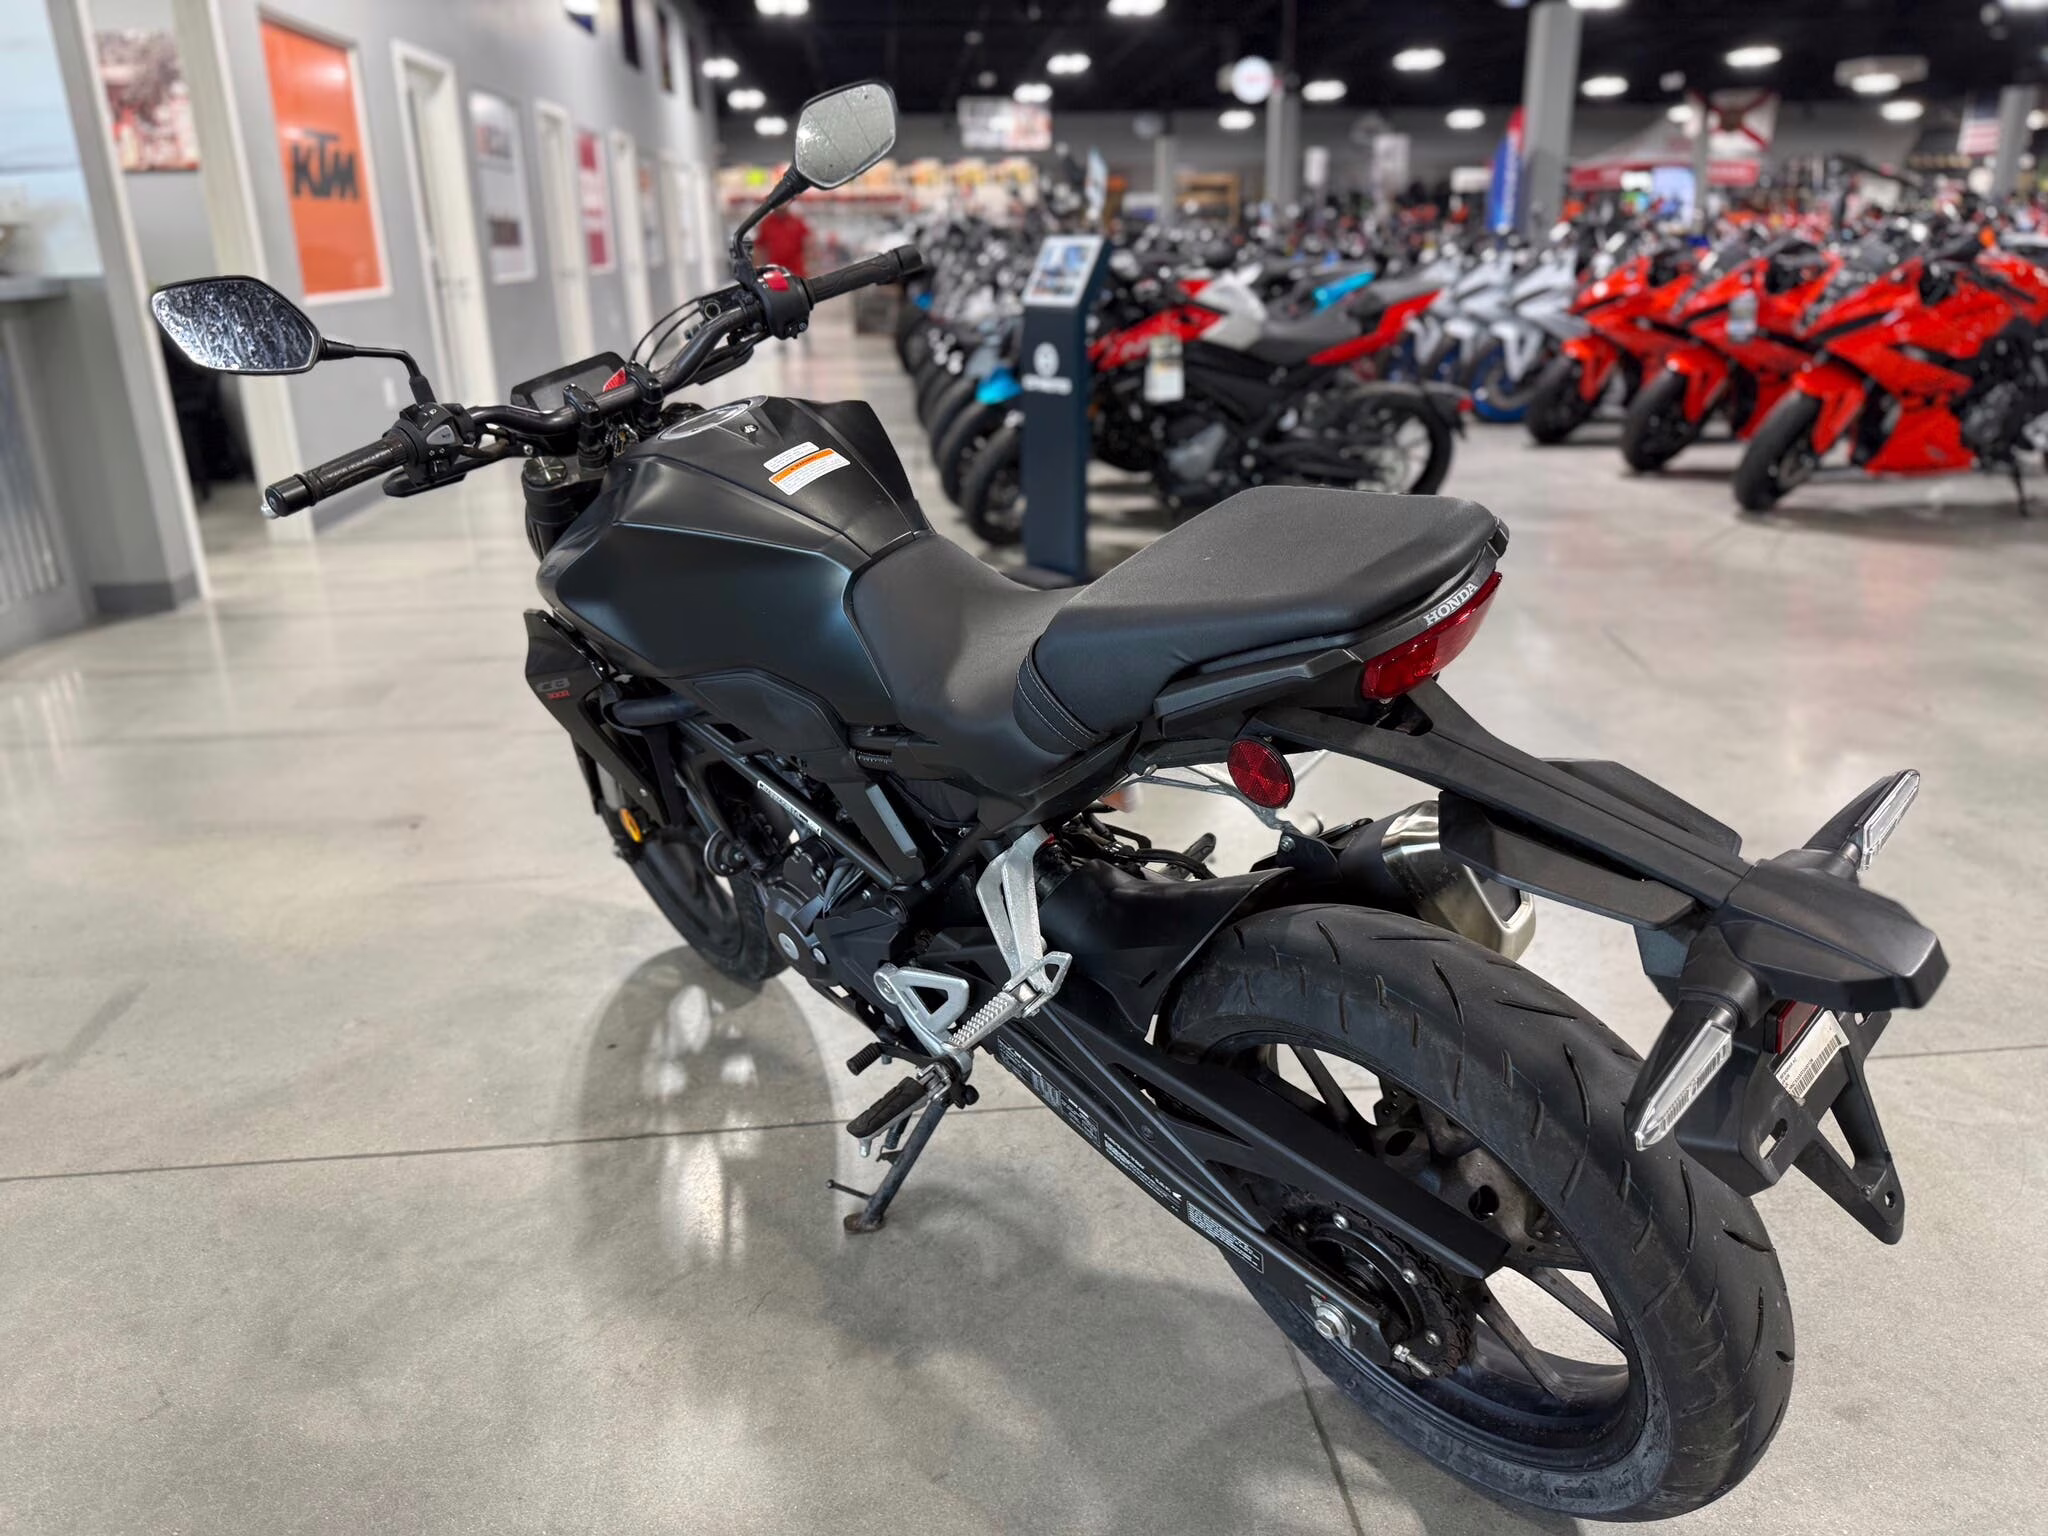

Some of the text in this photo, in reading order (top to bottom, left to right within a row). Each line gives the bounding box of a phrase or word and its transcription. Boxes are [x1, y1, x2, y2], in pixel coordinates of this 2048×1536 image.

[292, 131, 359, 202] KTM
[1423, 582, 1478, 627] HONDA
[536, 677, 570, 692] CB
